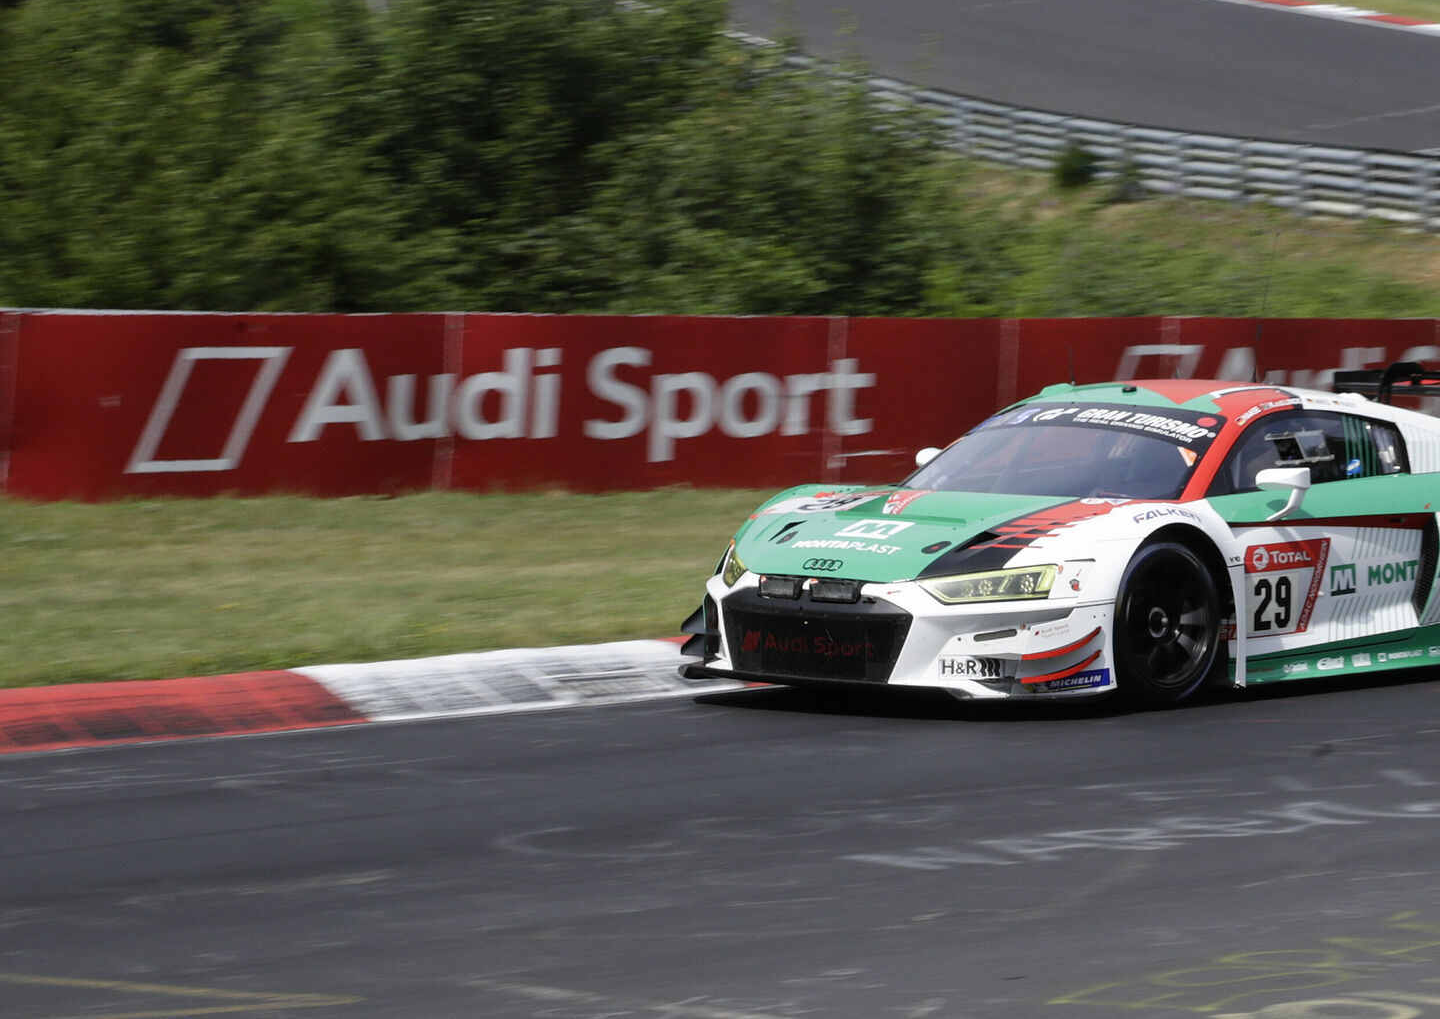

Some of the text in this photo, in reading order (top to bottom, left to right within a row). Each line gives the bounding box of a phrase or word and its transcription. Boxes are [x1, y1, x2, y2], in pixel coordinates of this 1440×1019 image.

[287, 346, 876, 461] Audi Sport
[1077, 408, 1132, 421] GRAN
[1133, 508, 1202, 523] FALKEN
[792, 540, 902, 555] MONTAPLAST
[1254, 576, 1292, 631] 29
[765, 632, 875, 658] Audi Sport
[942, 659, 979, 677] H&R
[1050, 675, 1102, 688] MICHELIN
